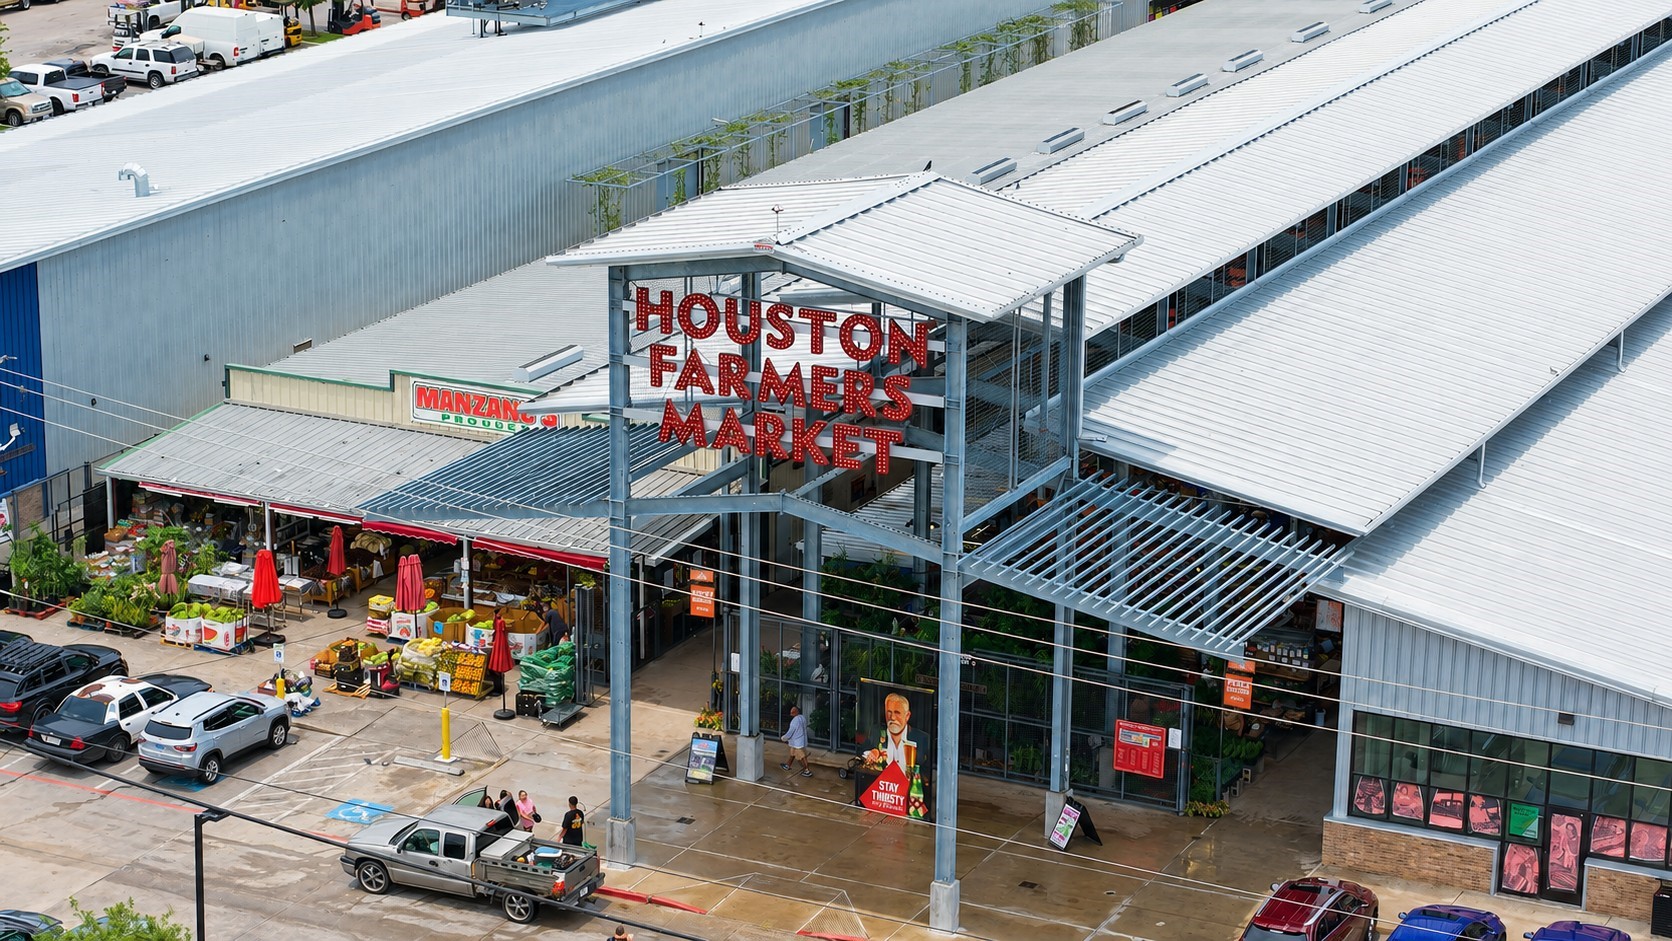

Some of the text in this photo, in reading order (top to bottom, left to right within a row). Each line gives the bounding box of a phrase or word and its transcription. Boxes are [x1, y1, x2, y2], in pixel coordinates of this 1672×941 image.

[636, 287, 932, 369] HOUSTON
[650, 343, 913, 422] FARMERS
[658, 398, 904, 475] MARKET
[872, 790, 905, 806] THIRSTY
[879, 780, 899, 793] STAY
